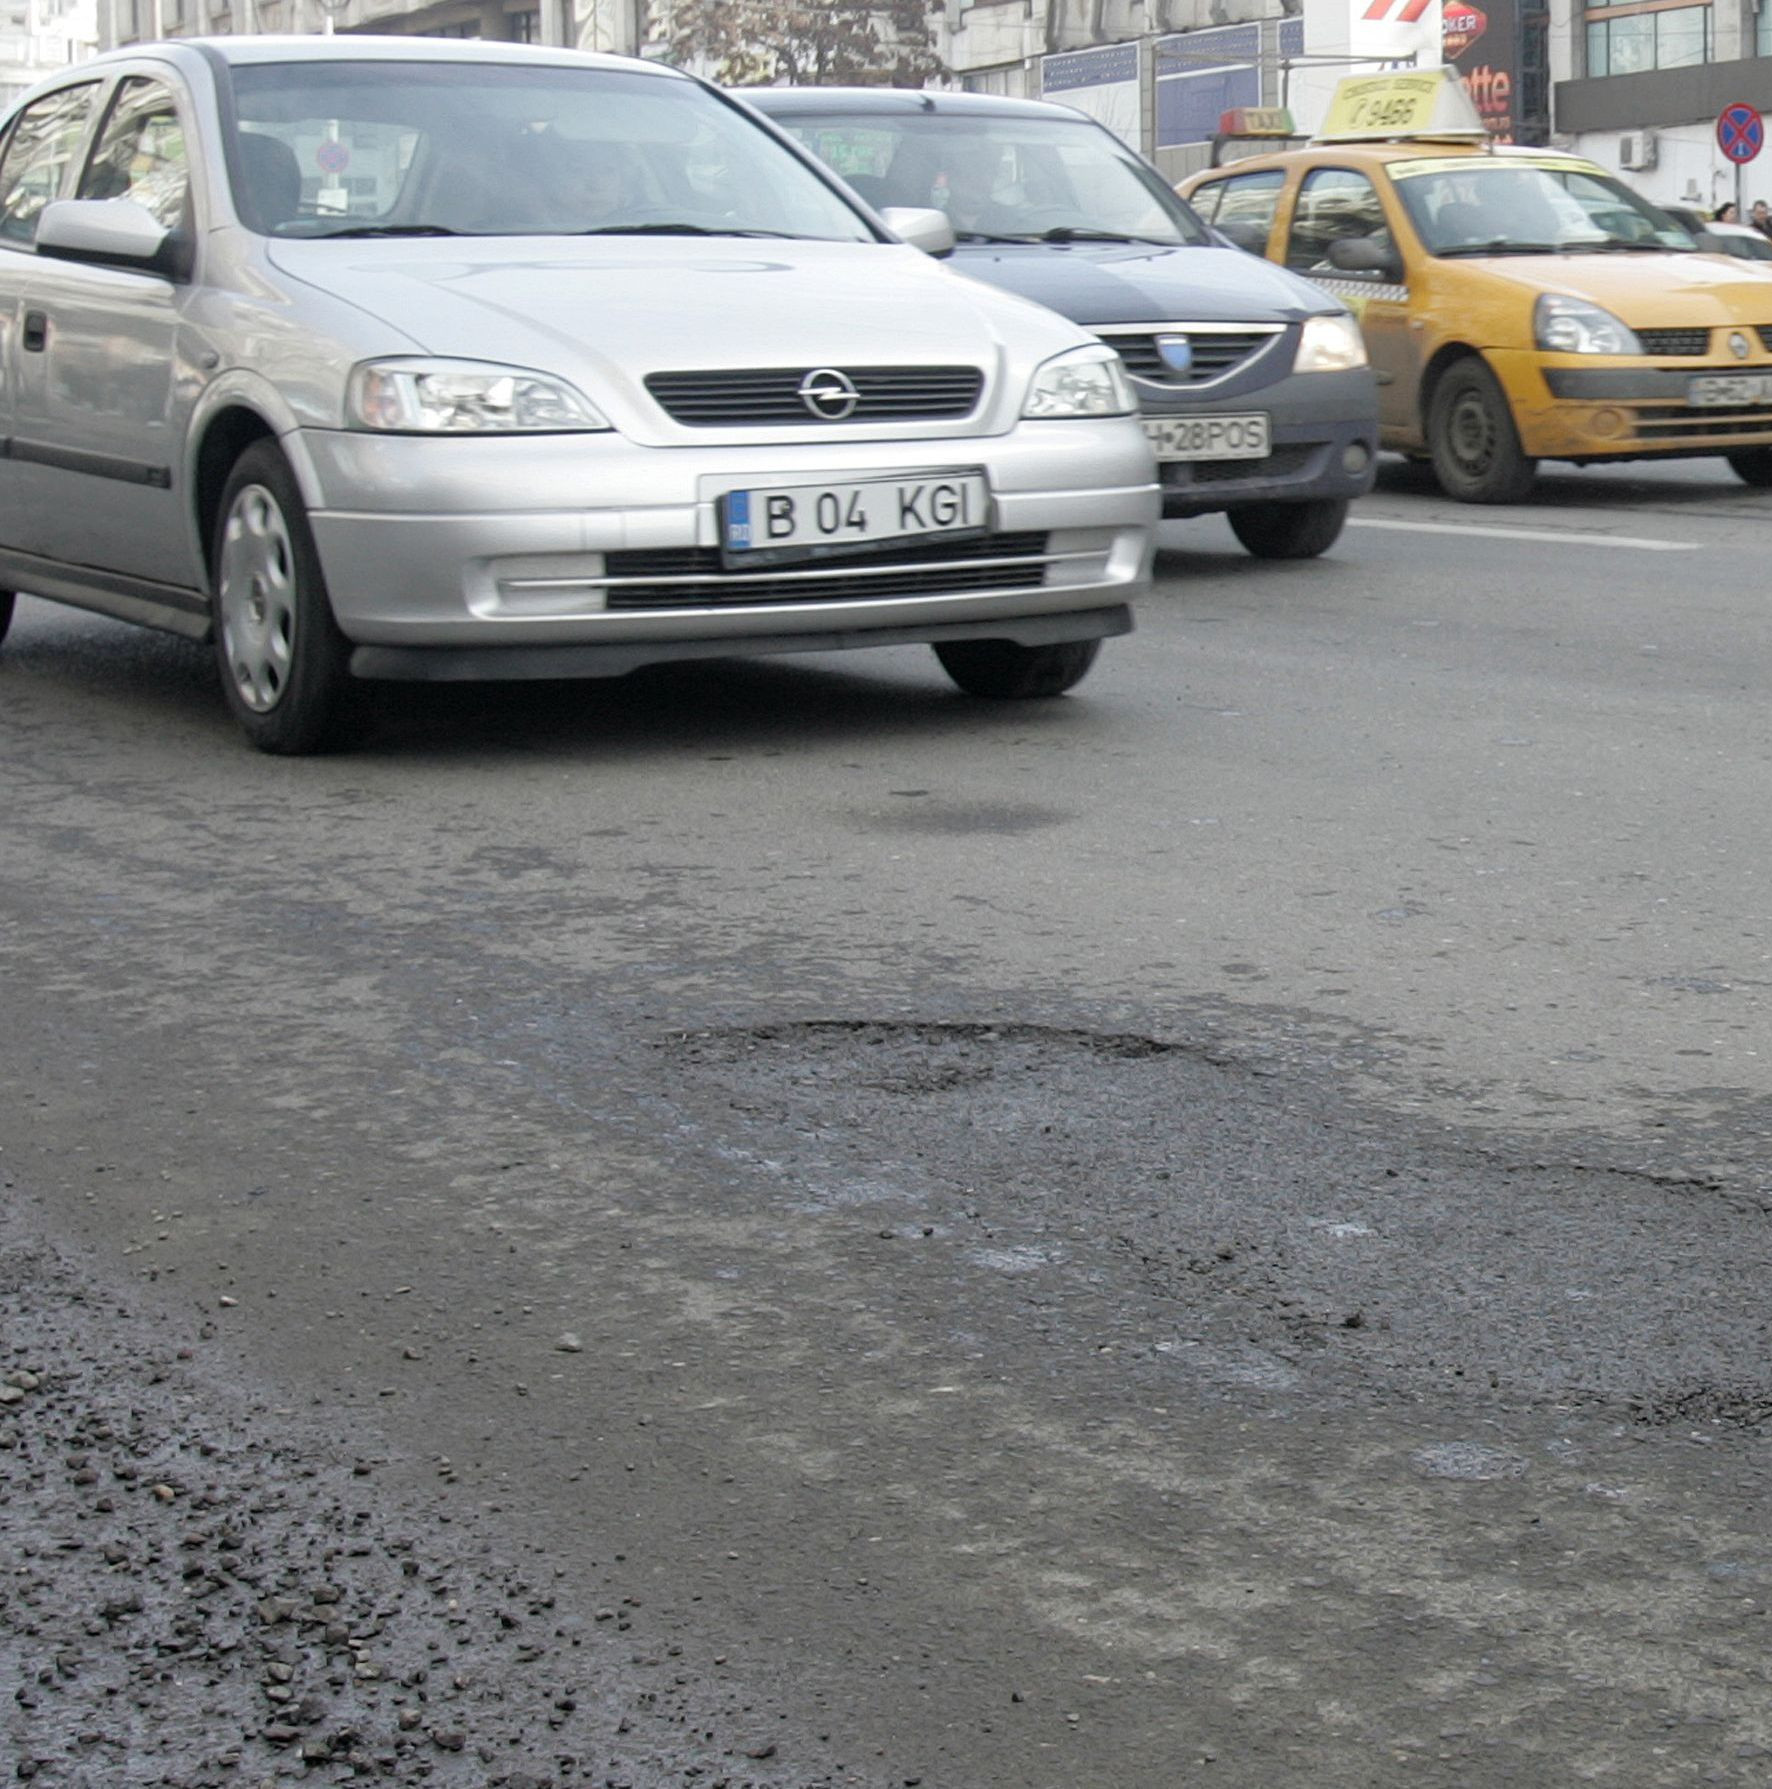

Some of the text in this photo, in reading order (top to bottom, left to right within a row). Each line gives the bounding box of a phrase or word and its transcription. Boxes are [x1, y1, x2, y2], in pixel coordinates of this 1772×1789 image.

[765, 482, 969, 540] B 04 KGI
